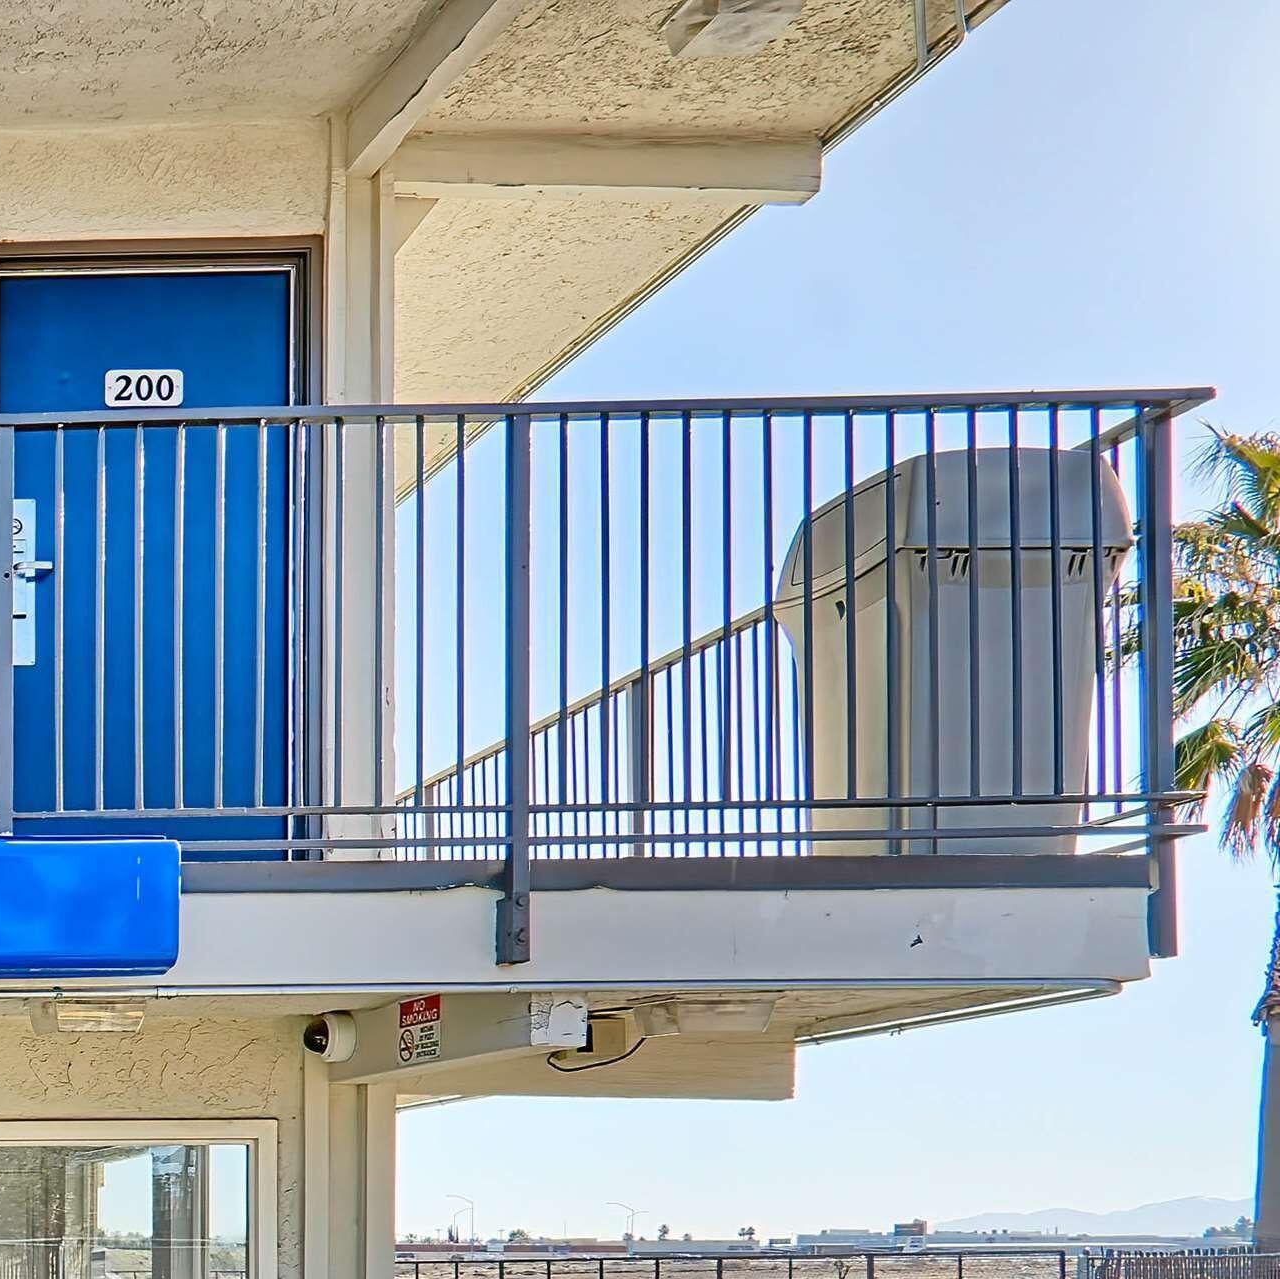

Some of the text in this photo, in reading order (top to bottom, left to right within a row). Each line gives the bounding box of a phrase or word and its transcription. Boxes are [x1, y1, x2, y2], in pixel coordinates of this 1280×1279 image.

[114, 374, 174, 401] 200
[413, 1000, 426, 1012] NO
[401, 1008, 438, 1026] SMOKING
